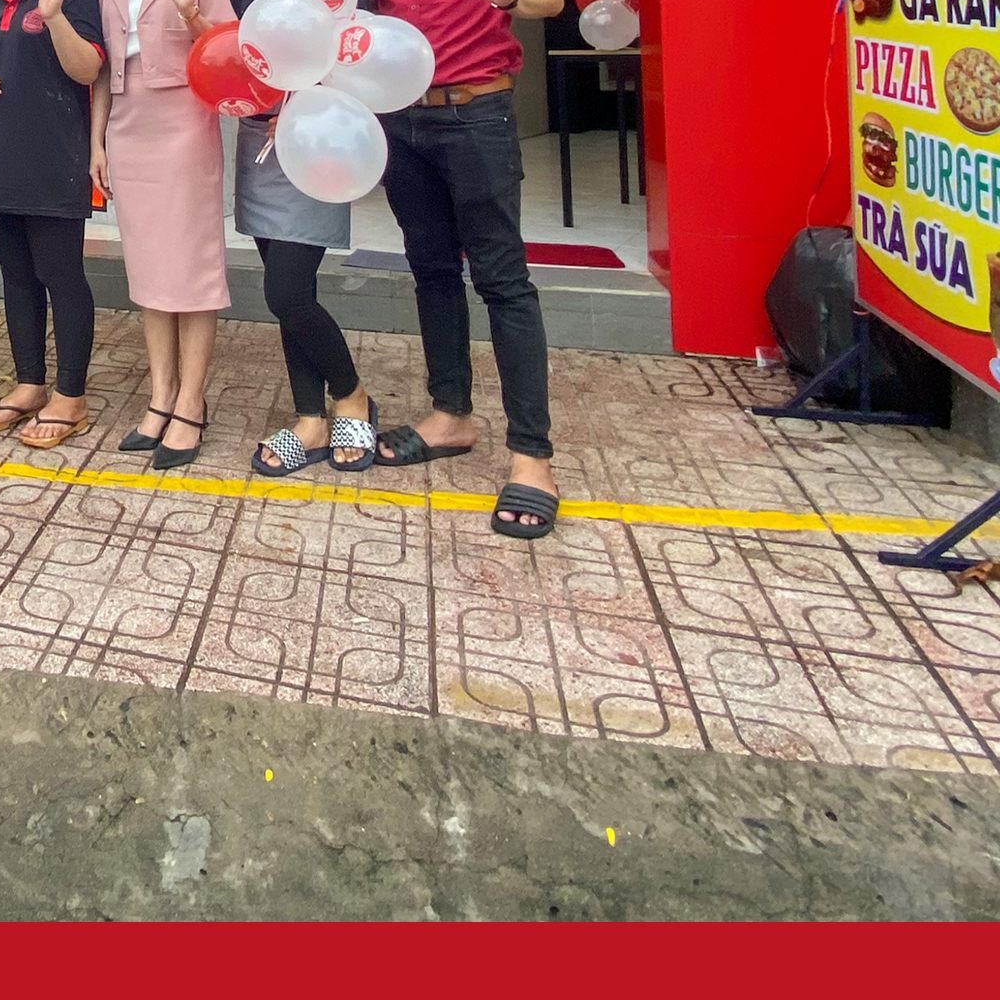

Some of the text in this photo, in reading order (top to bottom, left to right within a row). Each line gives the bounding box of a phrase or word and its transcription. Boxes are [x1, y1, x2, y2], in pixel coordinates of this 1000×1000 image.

[854, 39, 937, 110] PIZZA
[857, 194, 975, 299] TRÀ SỮA
